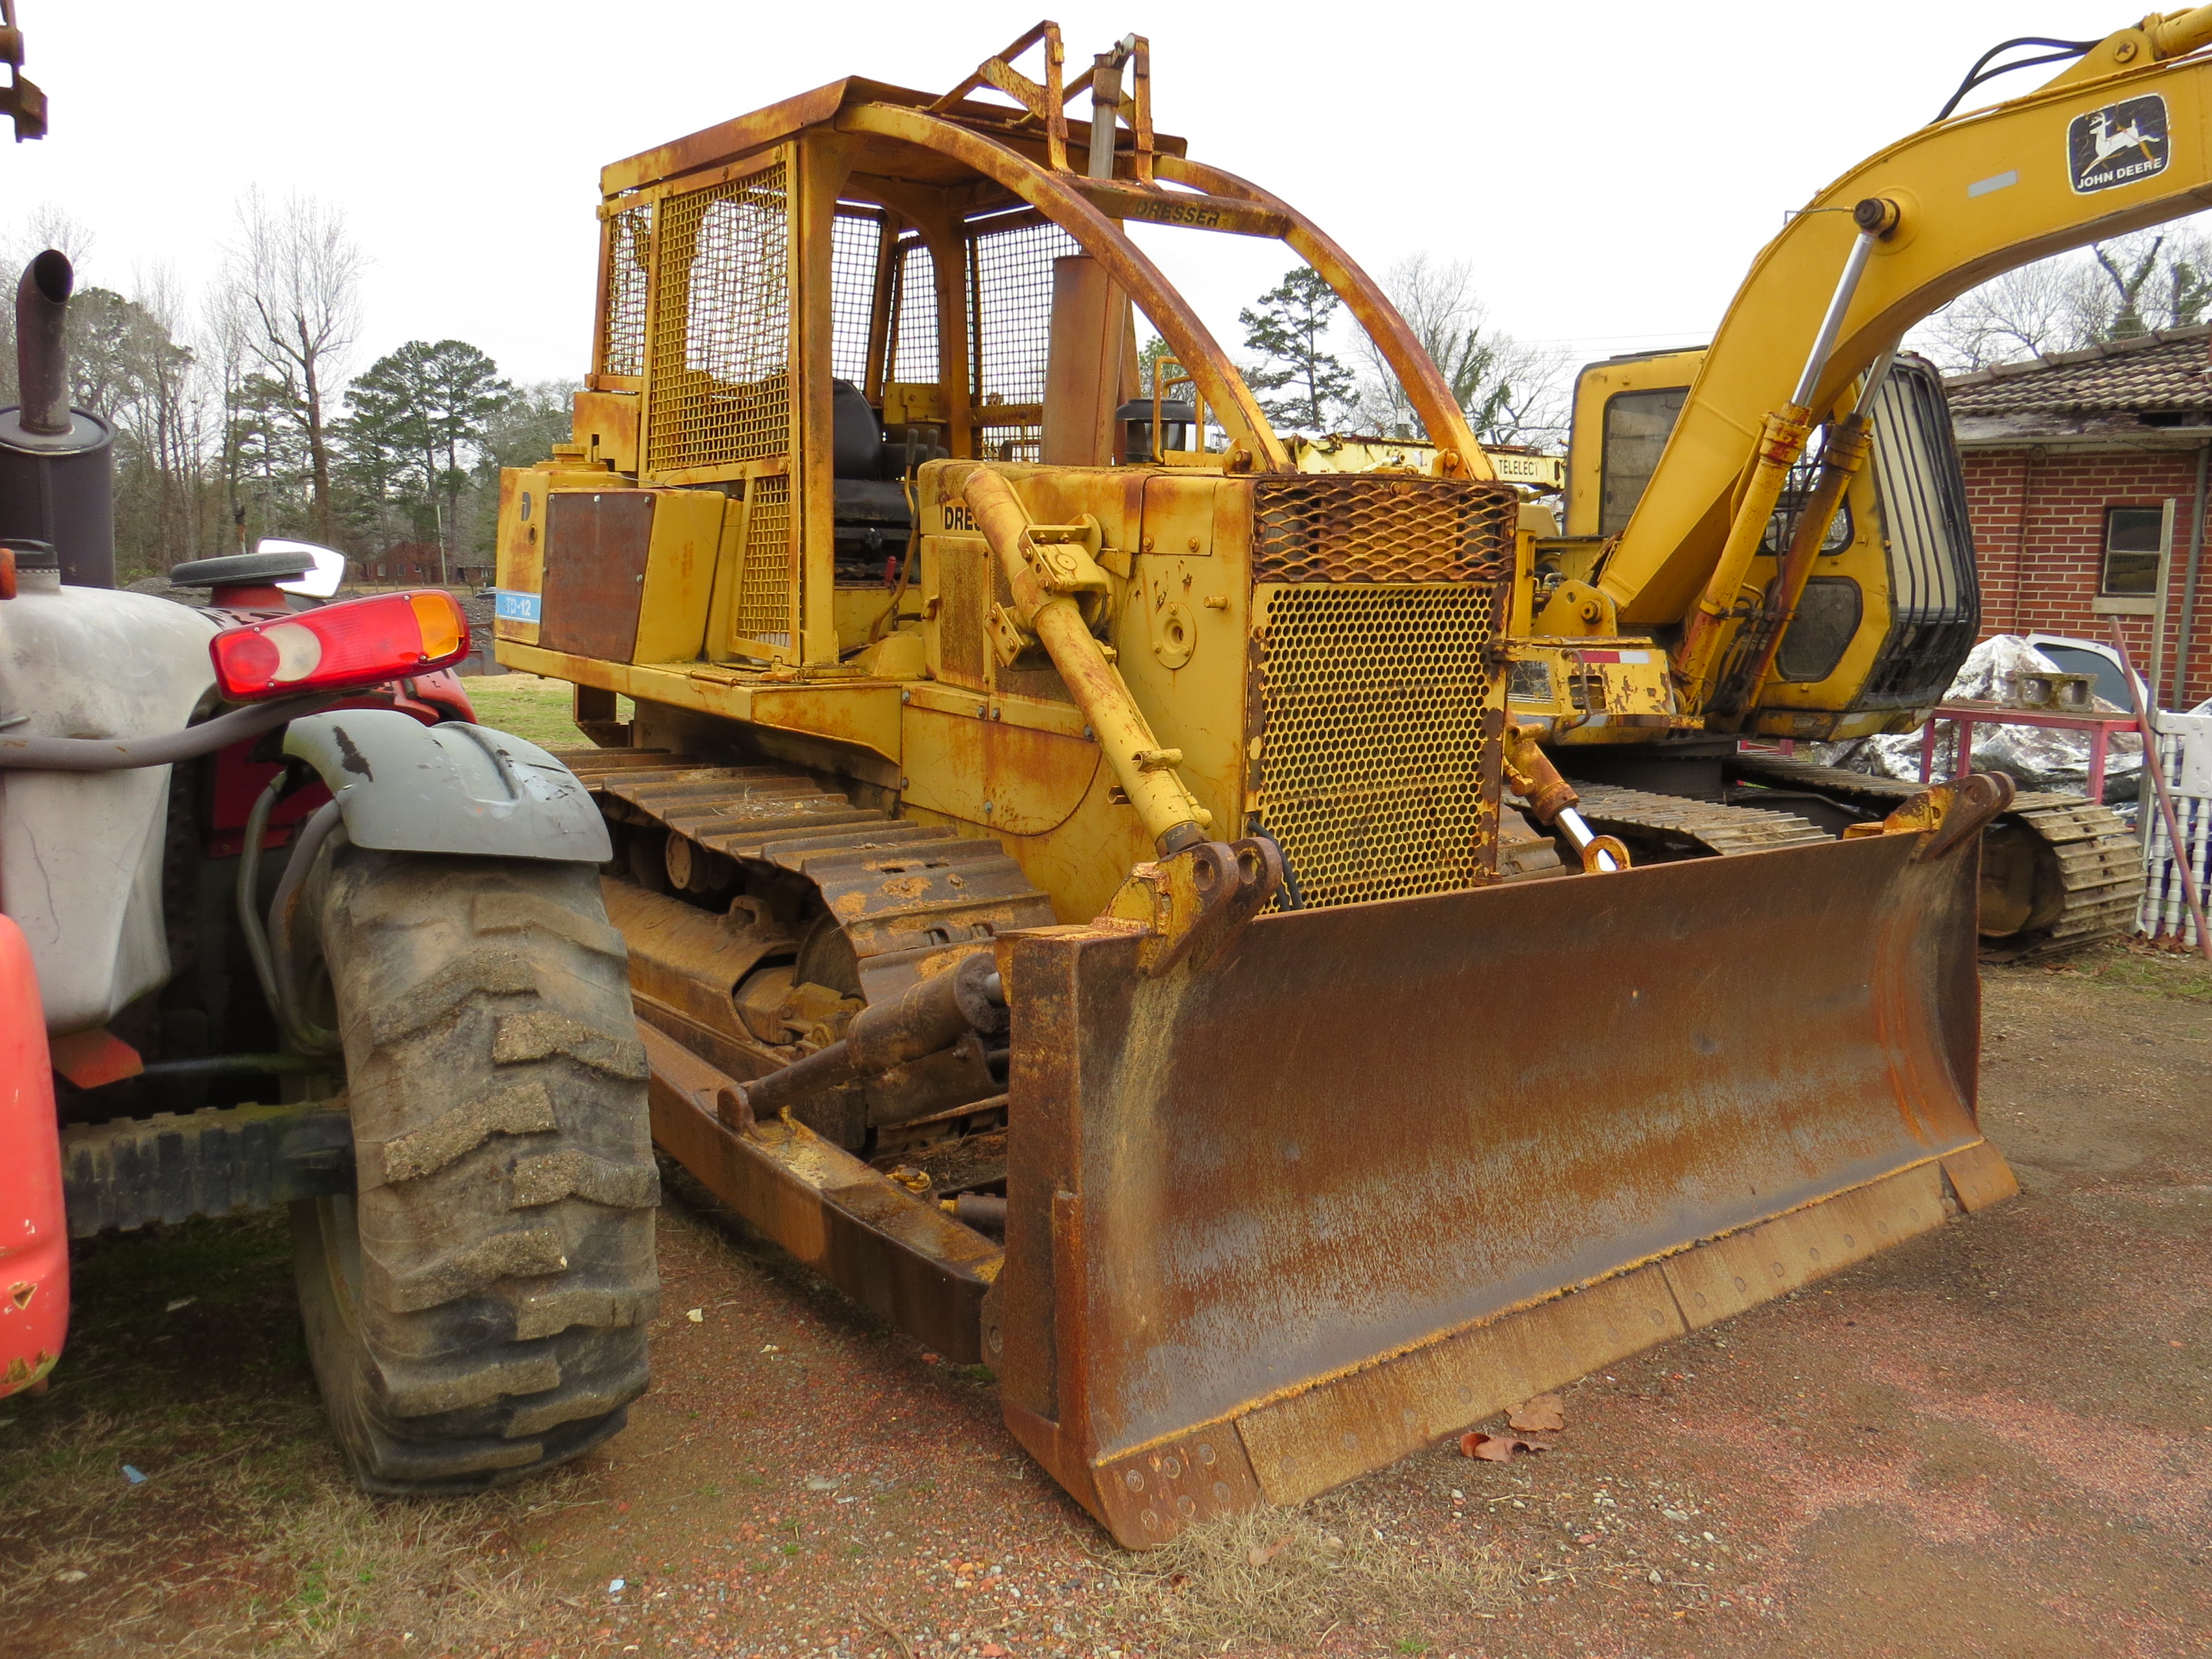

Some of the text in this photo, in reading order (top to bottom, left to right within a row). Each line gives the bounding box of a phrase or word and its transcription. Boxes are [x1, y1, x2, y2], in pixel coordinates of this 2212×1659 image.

[2077, 157, 2163, 189] JOHN DEERE
[1135, 200, 1220, 227] DRESSER
[506, 596, 531, 617] TD-12
